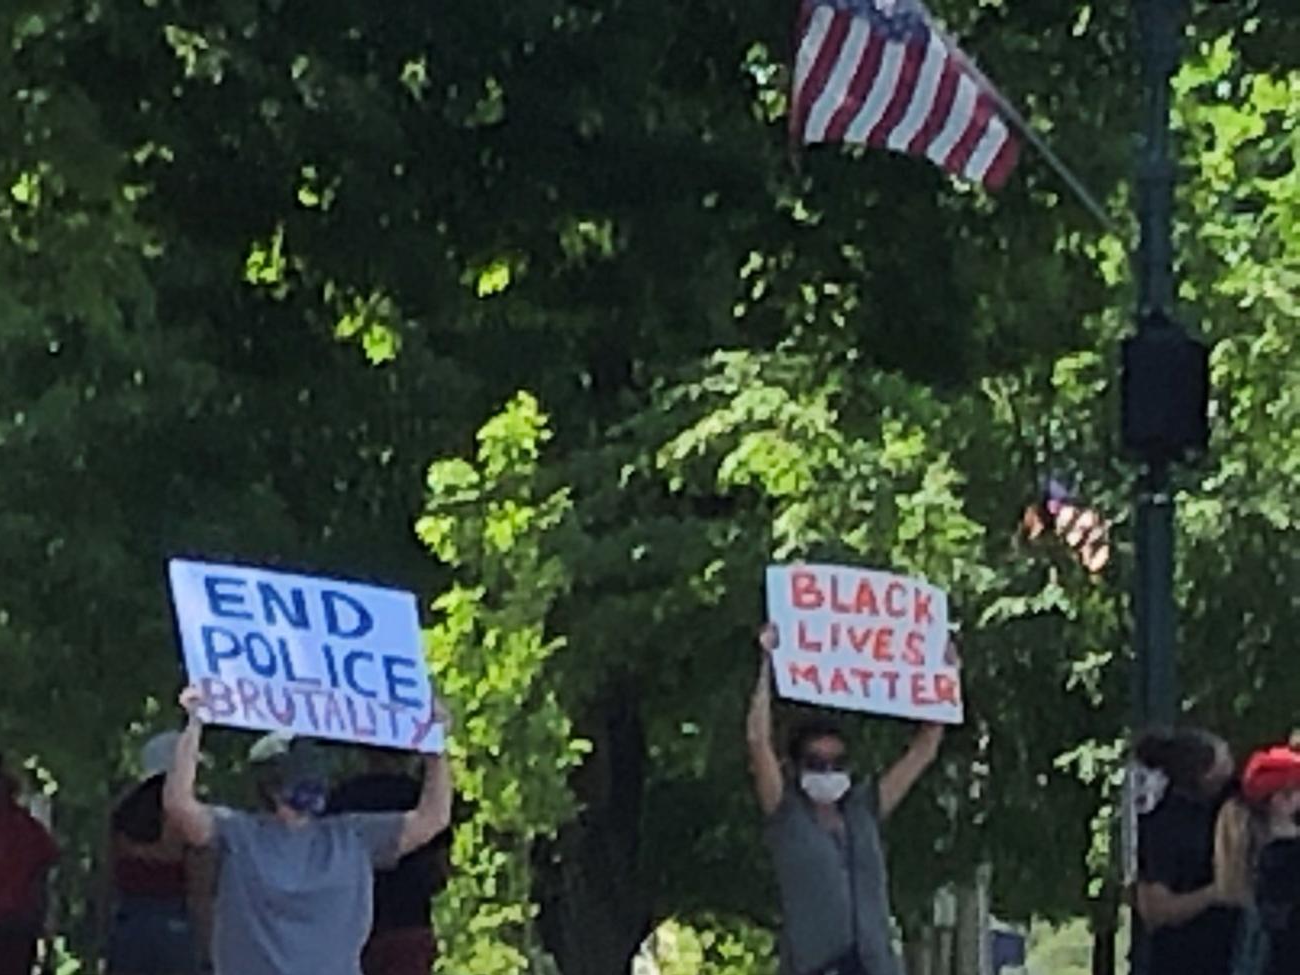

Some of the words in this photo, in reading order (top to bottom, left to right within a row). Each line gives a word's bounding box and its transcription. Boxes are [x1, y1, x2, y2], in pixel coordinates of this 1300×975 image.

[204, 576, 373, 638] END
[790, 571, 933, 624] BLACK
[201, 625, 424, 709] POLICE
[797, 620, 928, 668] LIVES
[200, 676, 436, 747] BRUTALITY
[787, 661, 959, 708] MATTER
